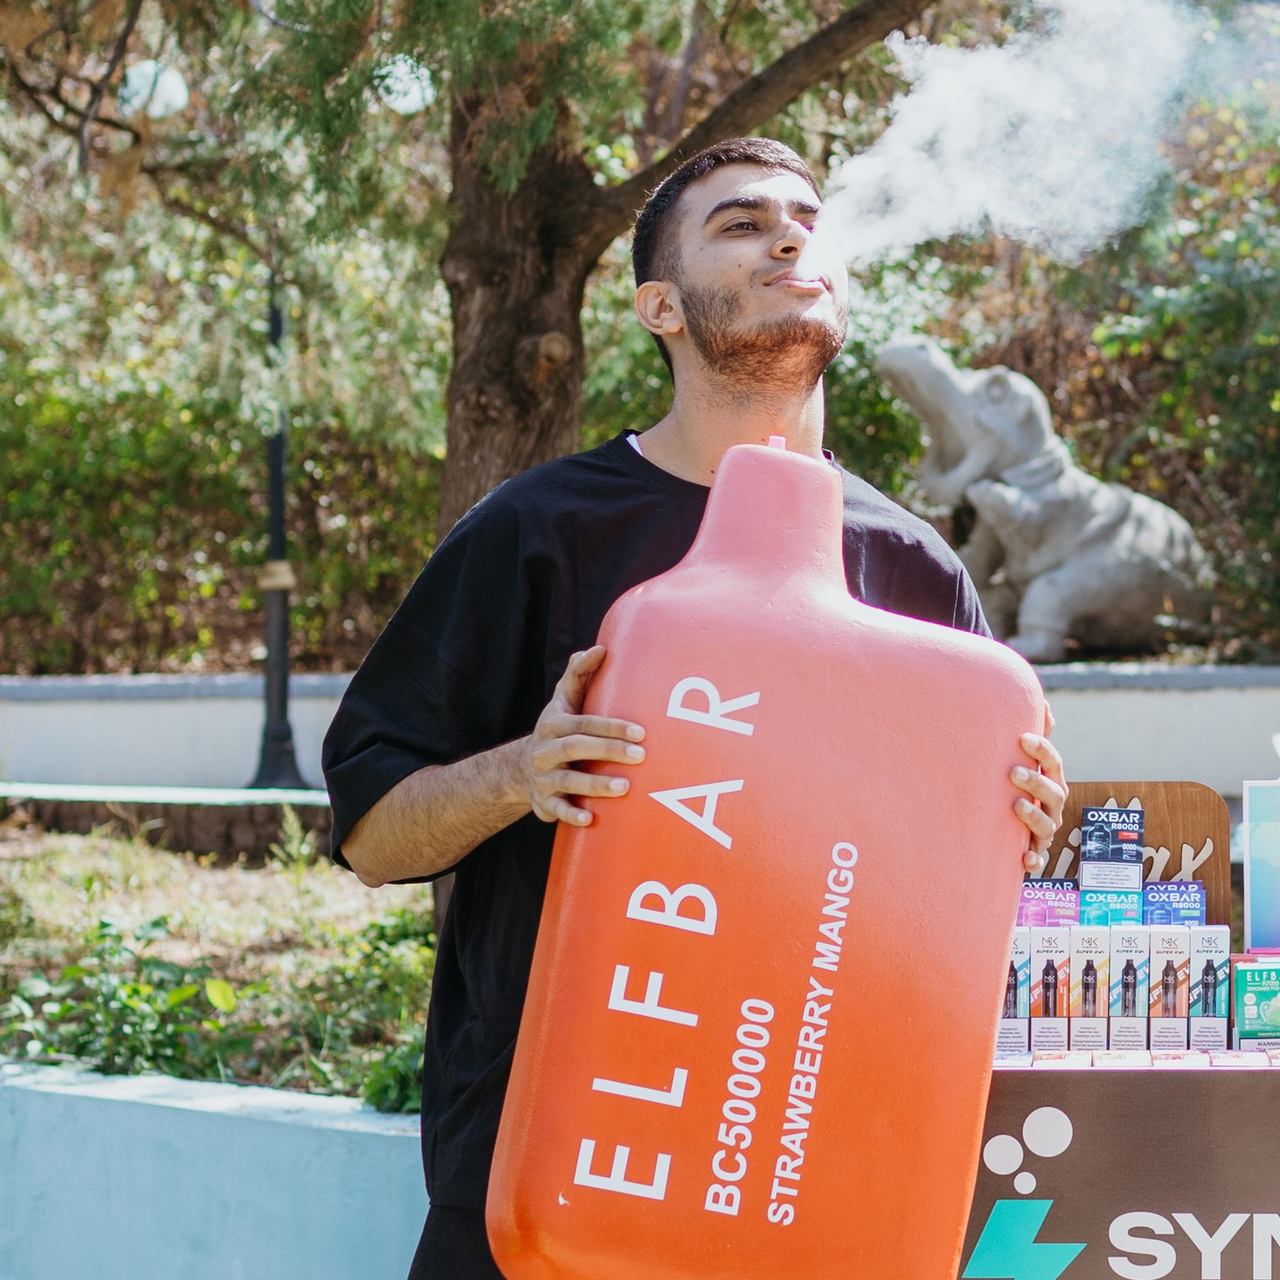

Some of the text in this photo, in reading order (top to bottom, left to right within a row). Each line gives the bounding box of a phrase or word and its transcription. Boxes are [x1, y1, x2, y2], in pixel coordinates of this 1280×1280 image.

[1087, 811, 1140, 823] OXBAR
[1111, 823, 1139, 831] R8000
[1023, 890, 1076, 902] OXBAR
[1085, 892, 1138, 903] OXBAR
[1148, 892, 1201, 903] OXBAR
[767, 841, 859, 1226] STRAWBERRY MANGO
[704, 997, 775, 1217] BC500000
